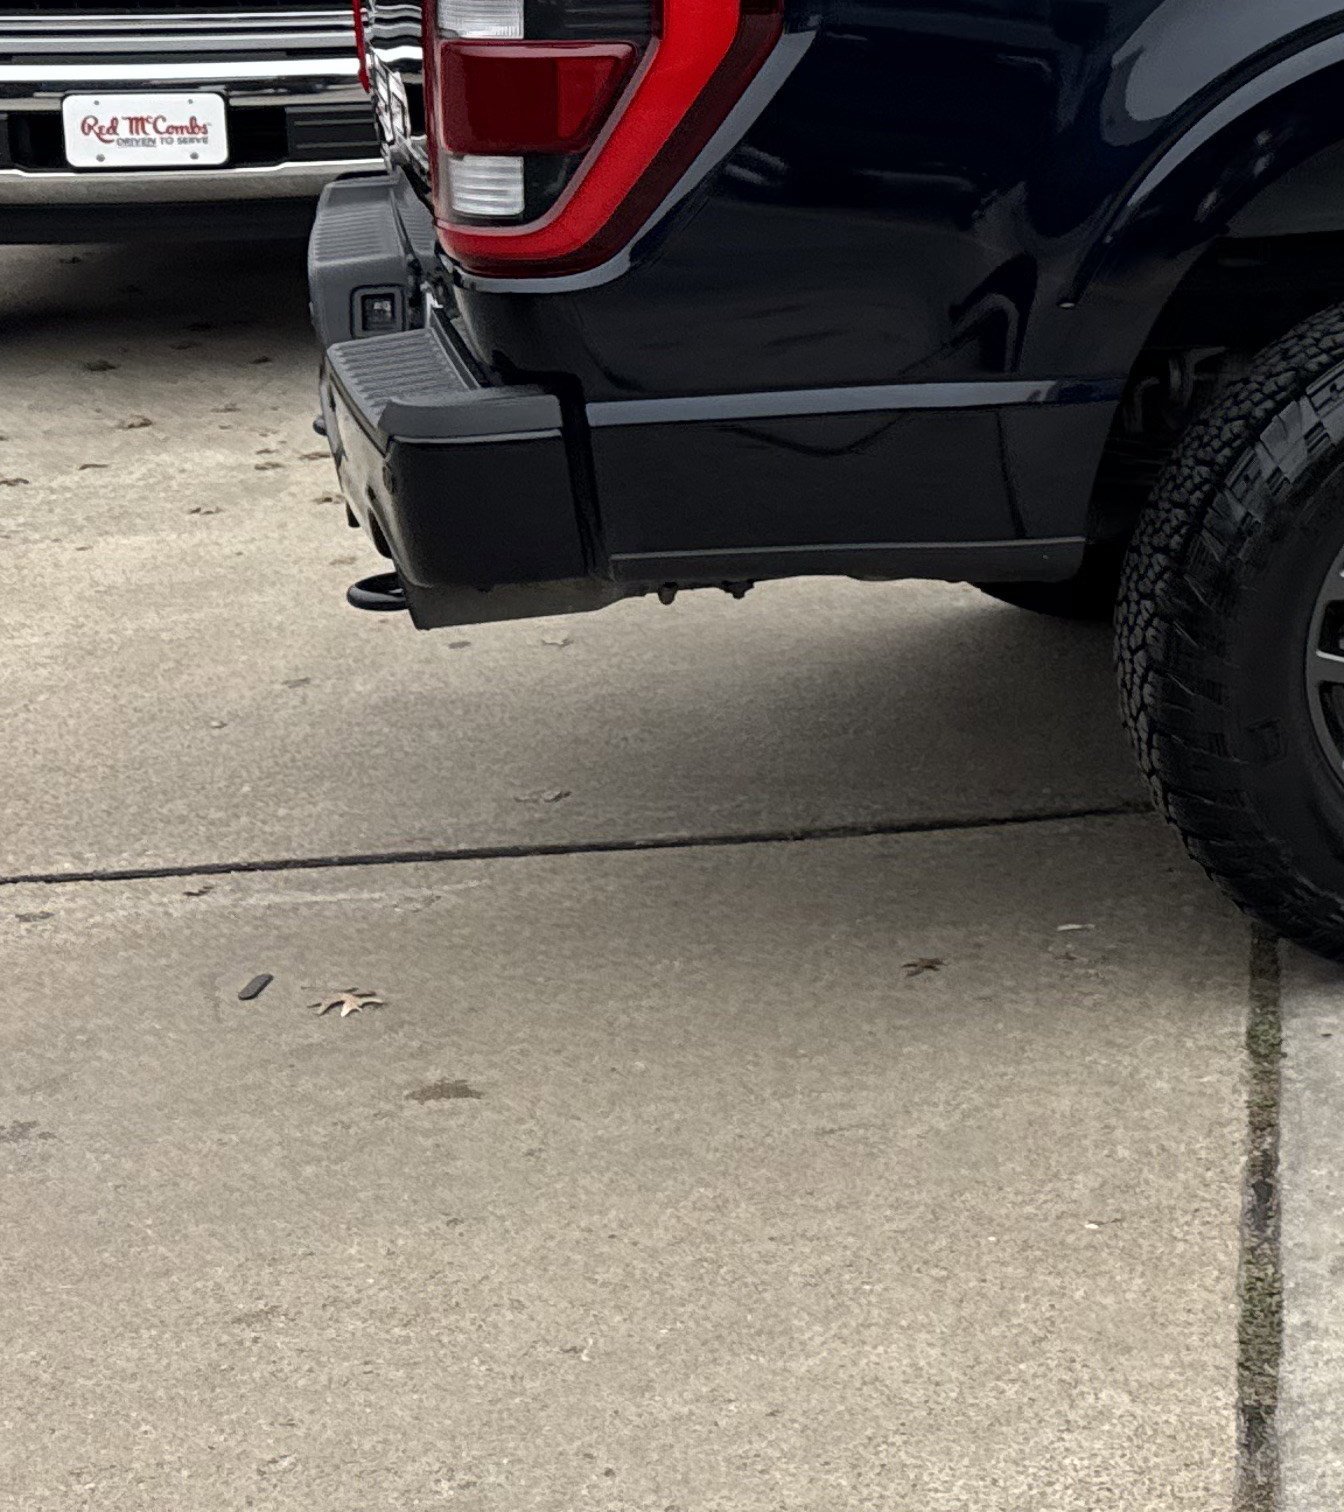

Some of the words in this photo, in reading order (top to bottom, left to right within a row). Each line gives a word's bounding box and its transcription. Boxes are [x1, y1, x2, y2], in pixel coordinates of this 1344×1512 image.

[81, 115, 119, 144] Red
[121, 115, 209, 136] McCombs
[116, 137, 157, 147] DRIVEN
[160, 136, 175, 145] TO
[177, 136, 209, 145] SERVE
